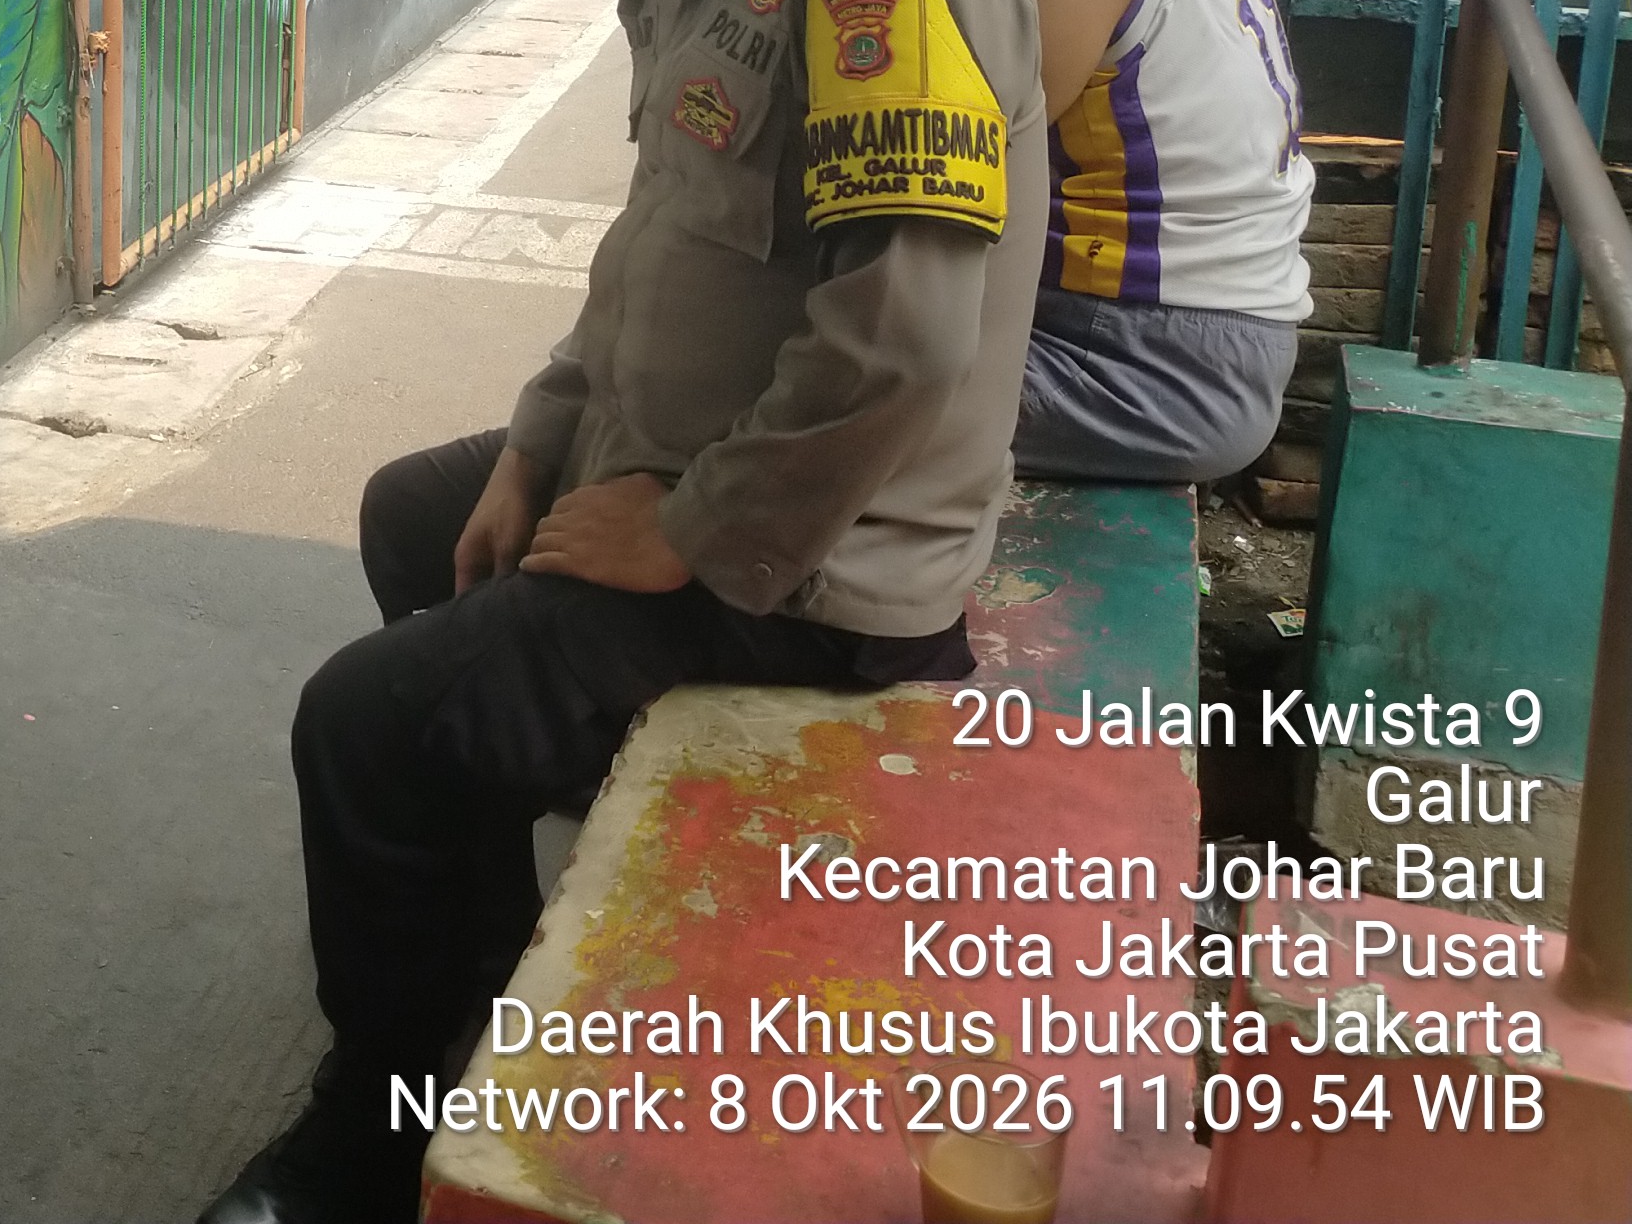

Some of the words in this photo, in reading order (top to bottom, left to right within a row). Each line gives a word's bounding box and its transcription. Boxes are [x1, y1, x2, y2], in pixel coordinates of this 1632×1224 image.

[702, 9, 777, 74] POLRI
[863, 156, 947, 177] GALUR
[830, 176, 910, 201] JOHAR
[922, 177, 985, 203] BARU
